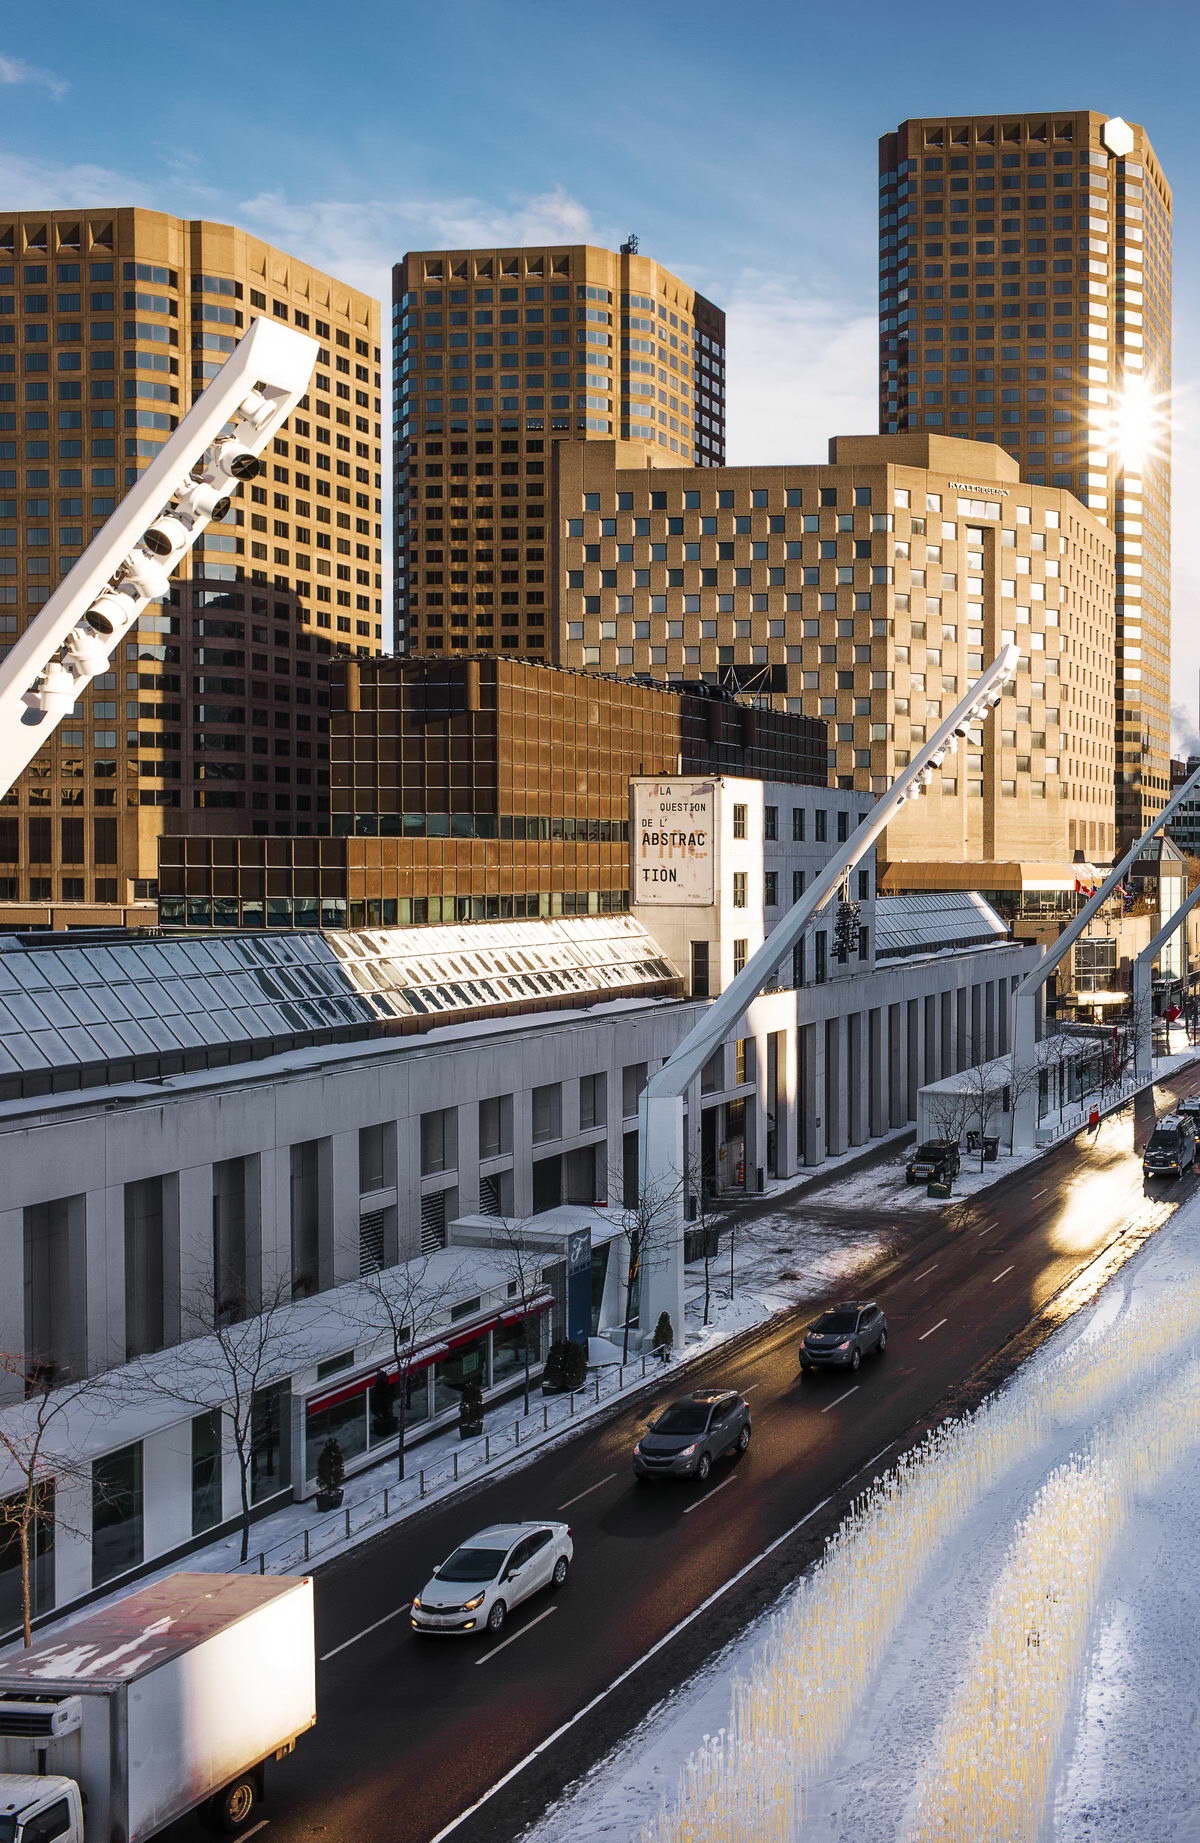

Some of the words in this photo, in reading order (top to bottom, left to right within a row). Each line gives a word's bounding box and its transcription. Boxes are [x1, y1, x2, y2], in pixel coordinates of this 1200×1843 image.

[659, 786, 672, 796] LA
[659, 802, 706, 812] QUESTION
[641, 818, 653, 828] DE
[659, 817, 668, 828] L'
[642, 832, 705, 846] ABSTRAC
[642, 868, 677, 882] TION
